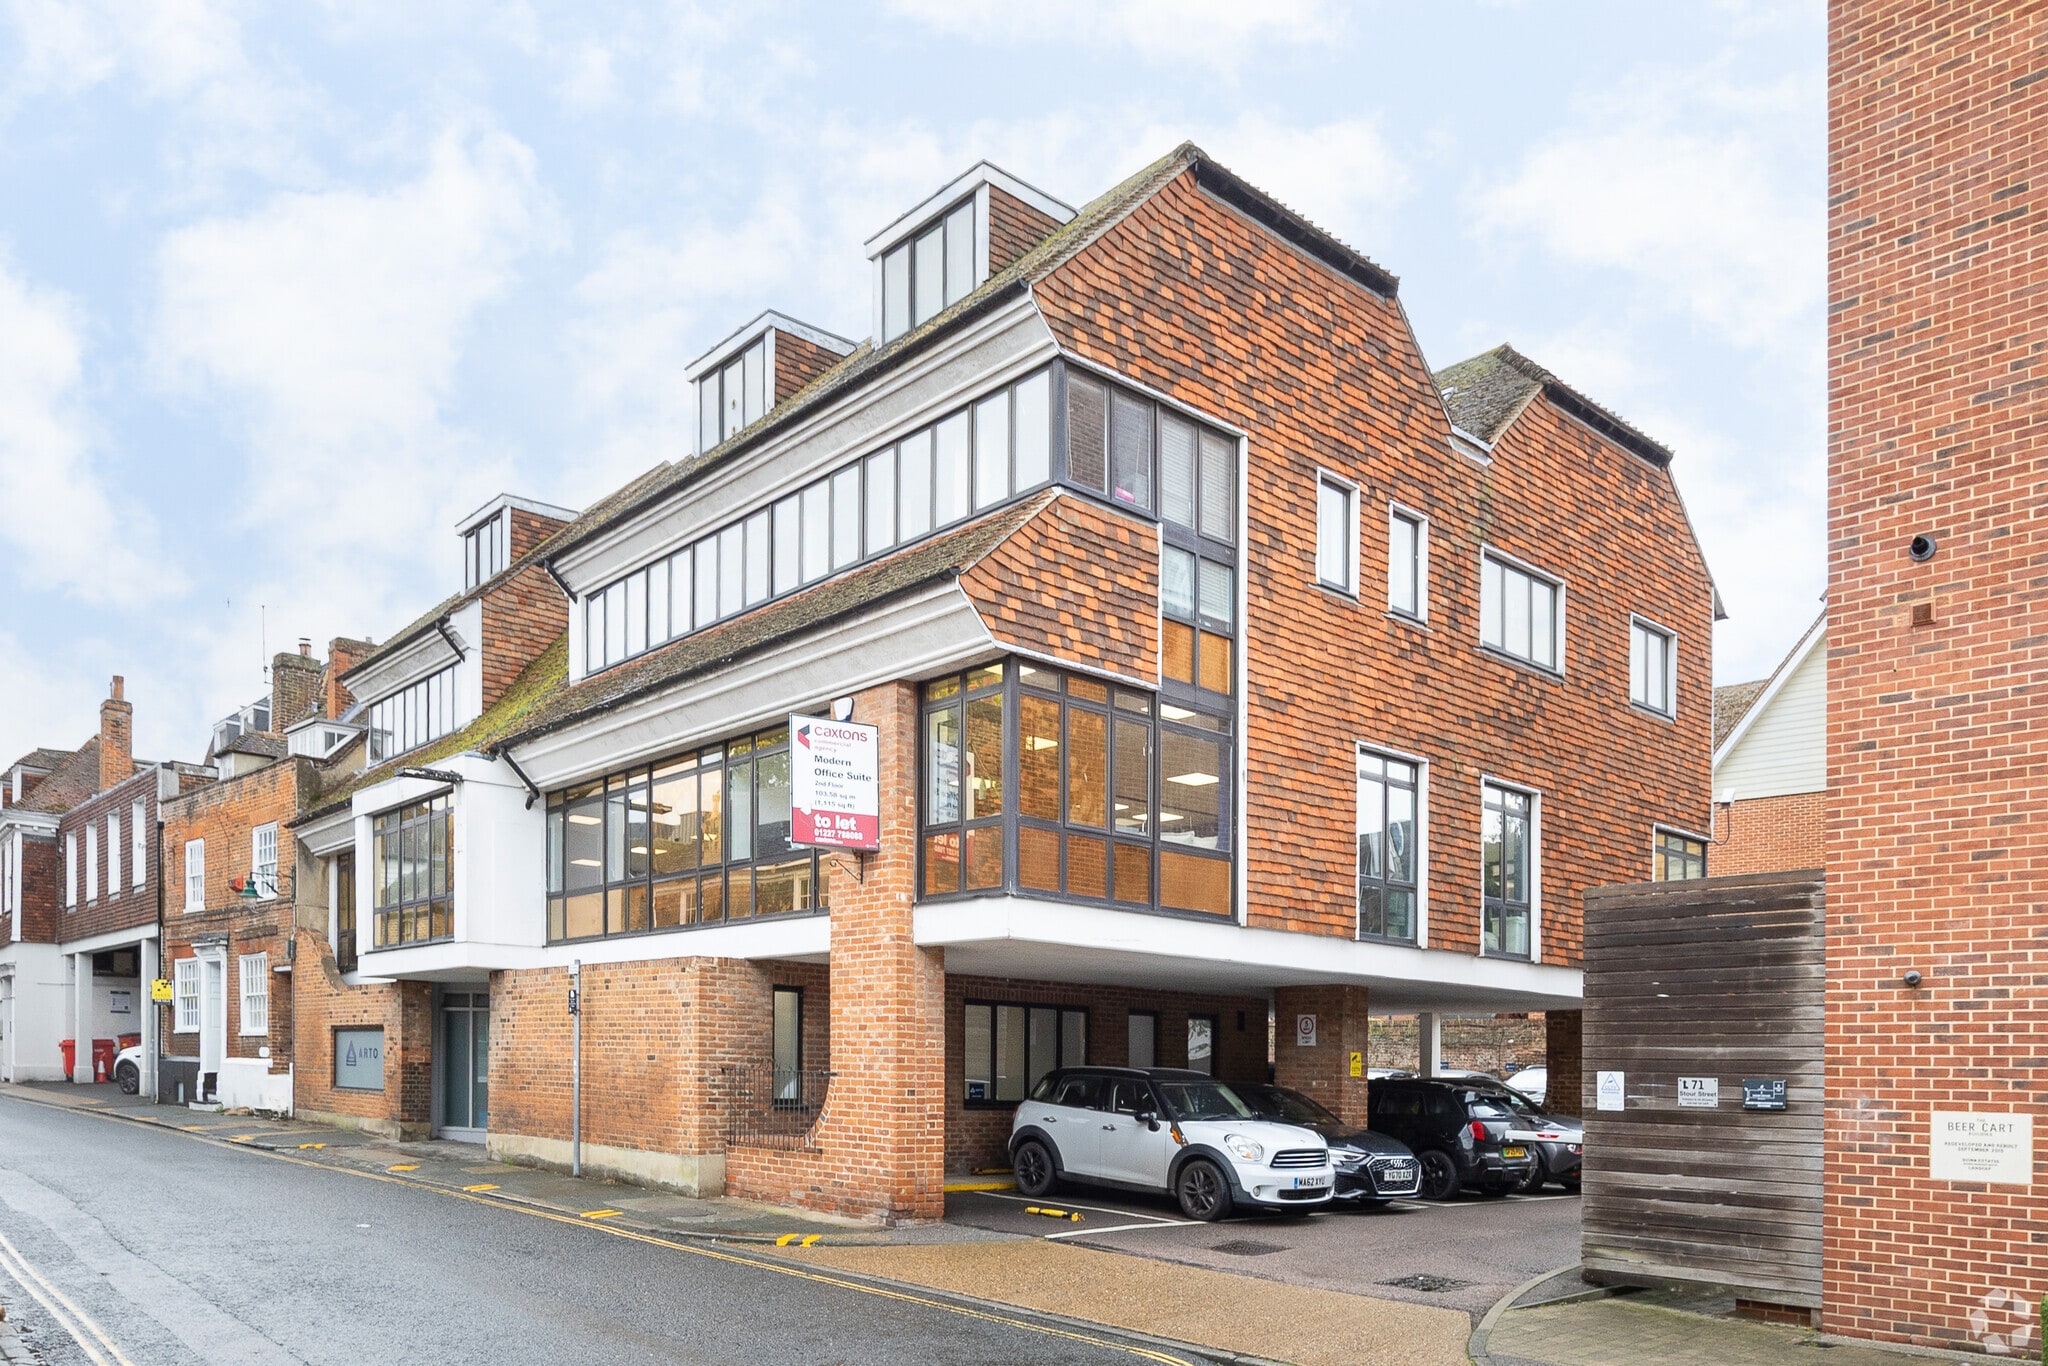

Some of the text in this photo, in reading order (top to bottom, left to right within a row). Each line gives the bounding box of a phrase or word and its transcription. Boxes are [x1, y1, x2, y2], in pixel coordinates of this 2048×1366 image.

[814, 726, 868, 742] caxtons
[814, 755, 852, 766] Modern
[814, 768, 872, 782] Office Suite
[814, 813, 857, 831] to let
[814, 828, 836, 838] 01227
[358, 1047, 379, 1059] ARTO
[1691, 1080, 1704, 1090] 71
[1947, 1121, 2014, 1133] BEER CART
[1299, 1177, 1315, 1188] MA62
